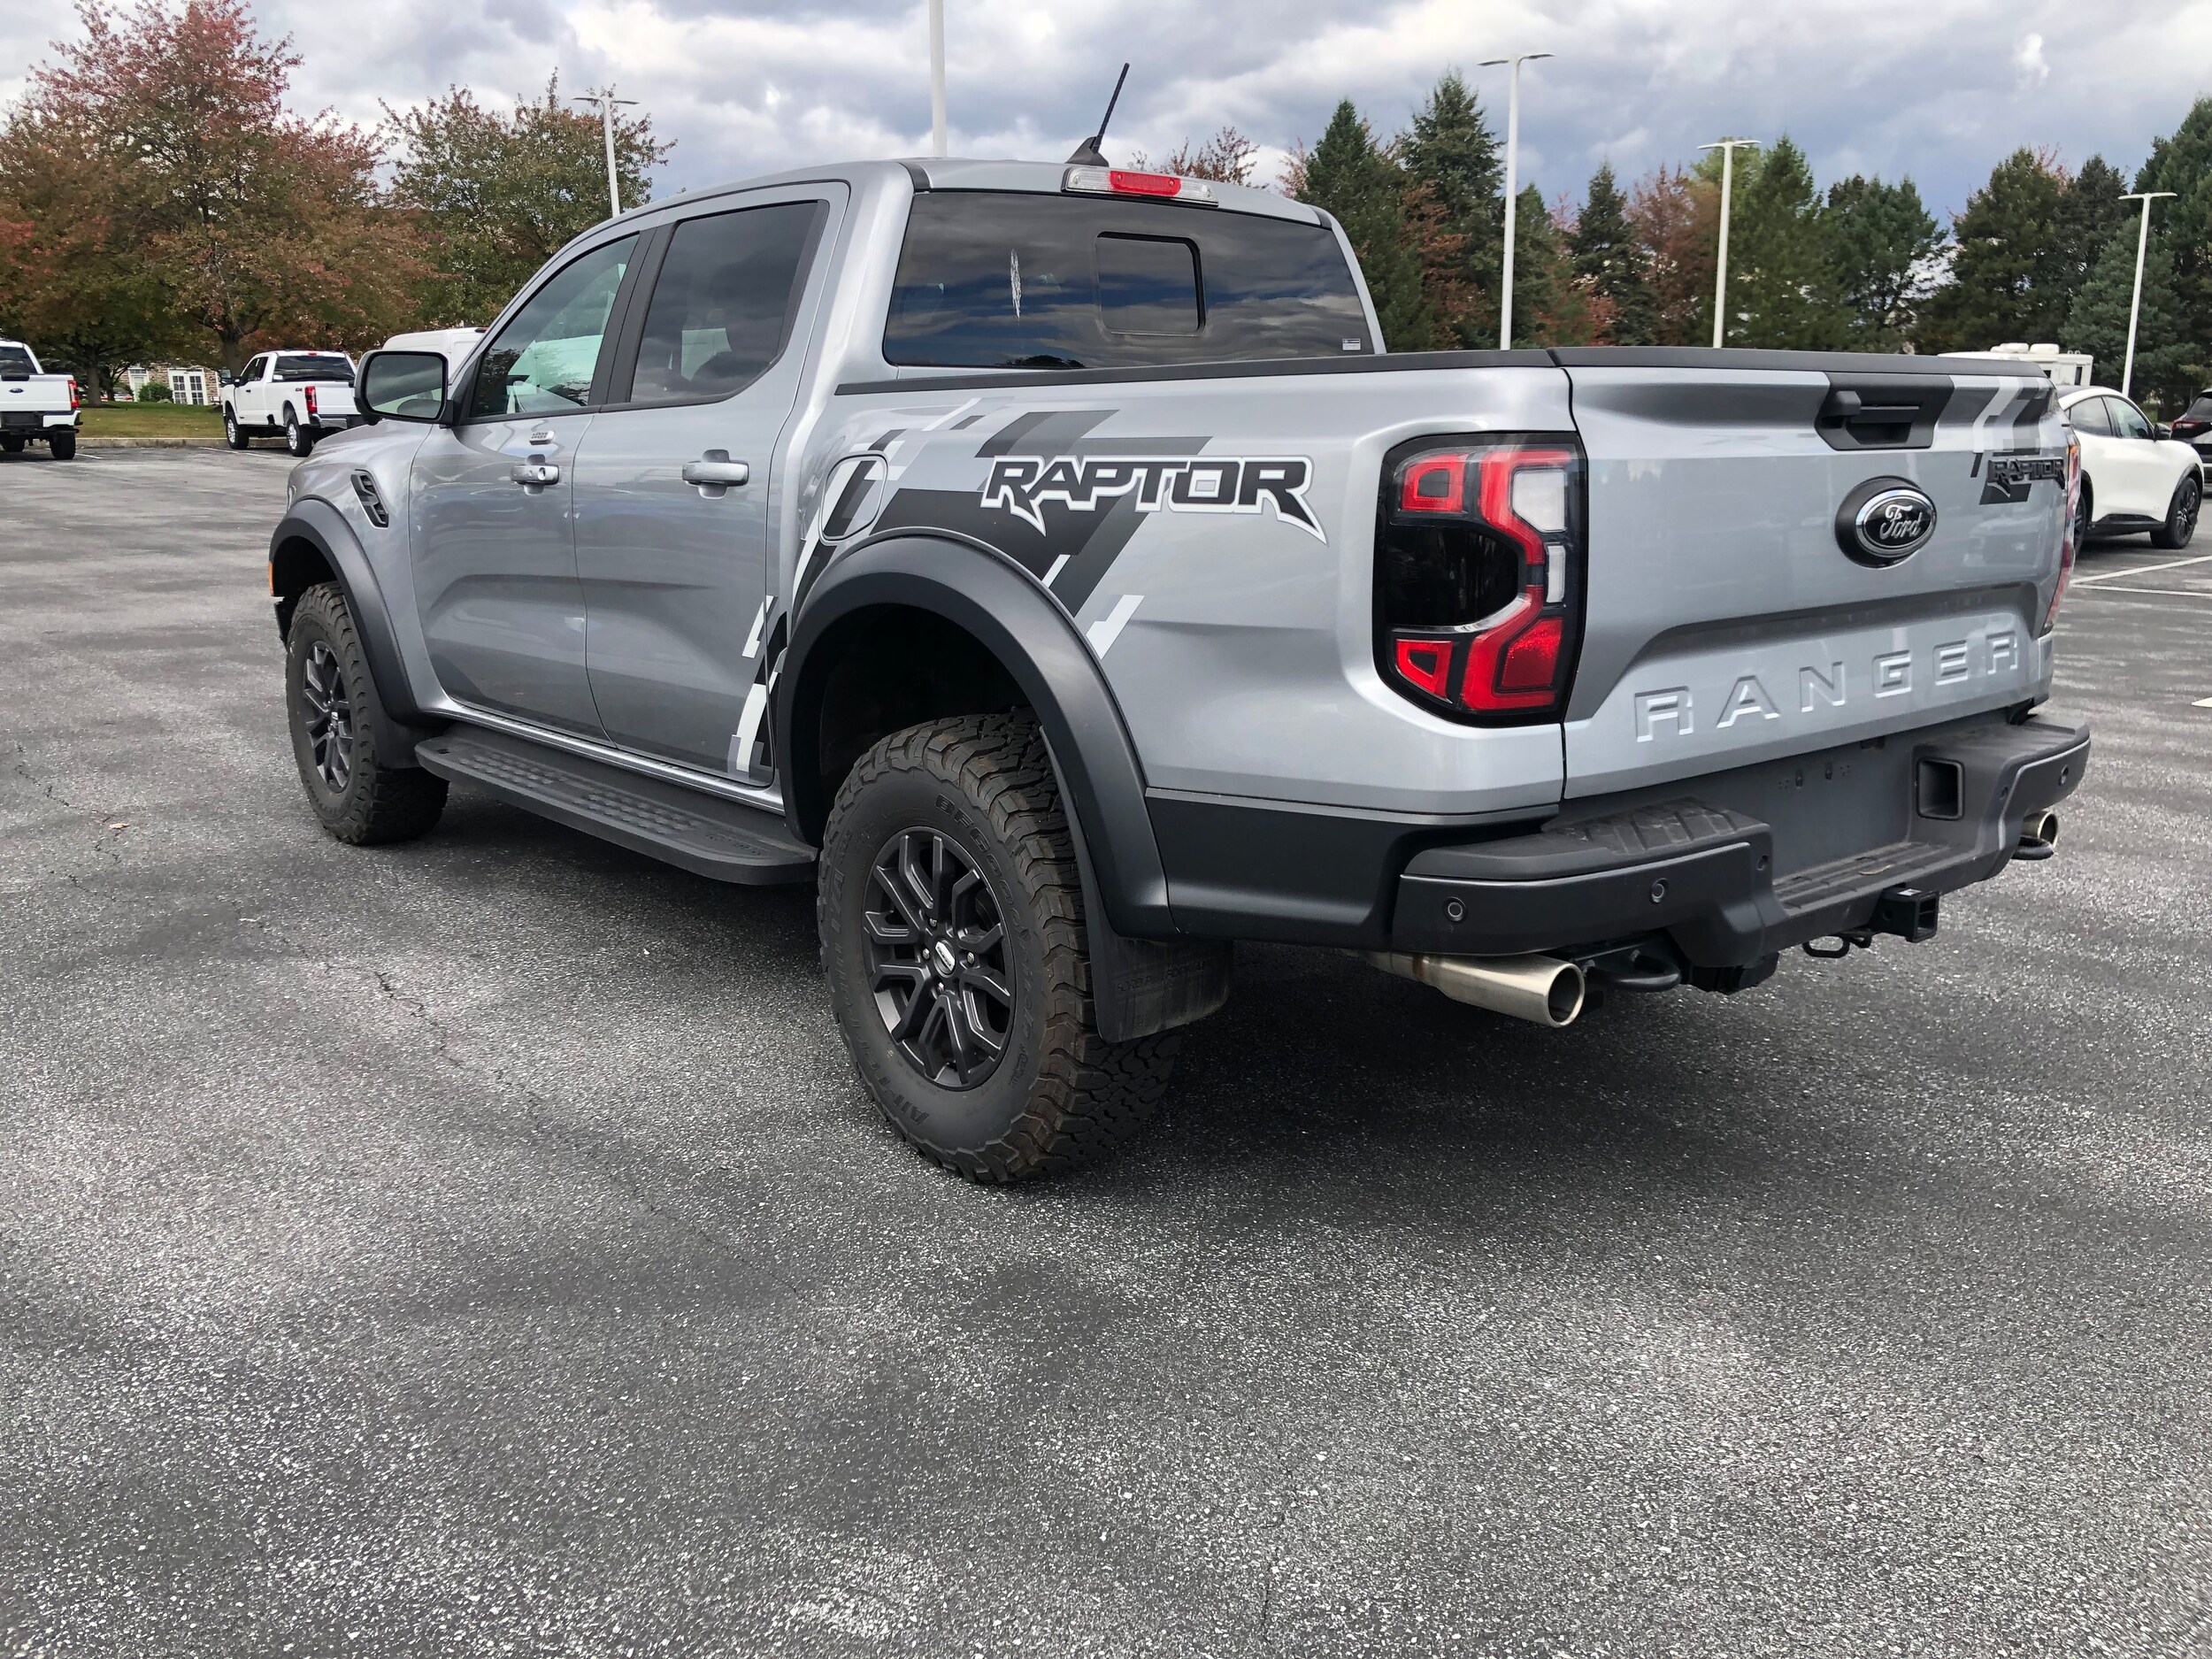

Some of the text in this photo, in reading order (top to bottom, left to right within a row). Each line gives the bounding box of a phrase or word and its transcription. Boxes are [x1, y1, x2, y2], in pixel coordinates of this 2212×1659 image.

[980, 455, 1328, 546] RAPTOR
[1987, 457, 2066, 496] RAPTOR
[1879, 504, 1921, 540] Ford
[1634, 630, 2018, 742] RANGER
